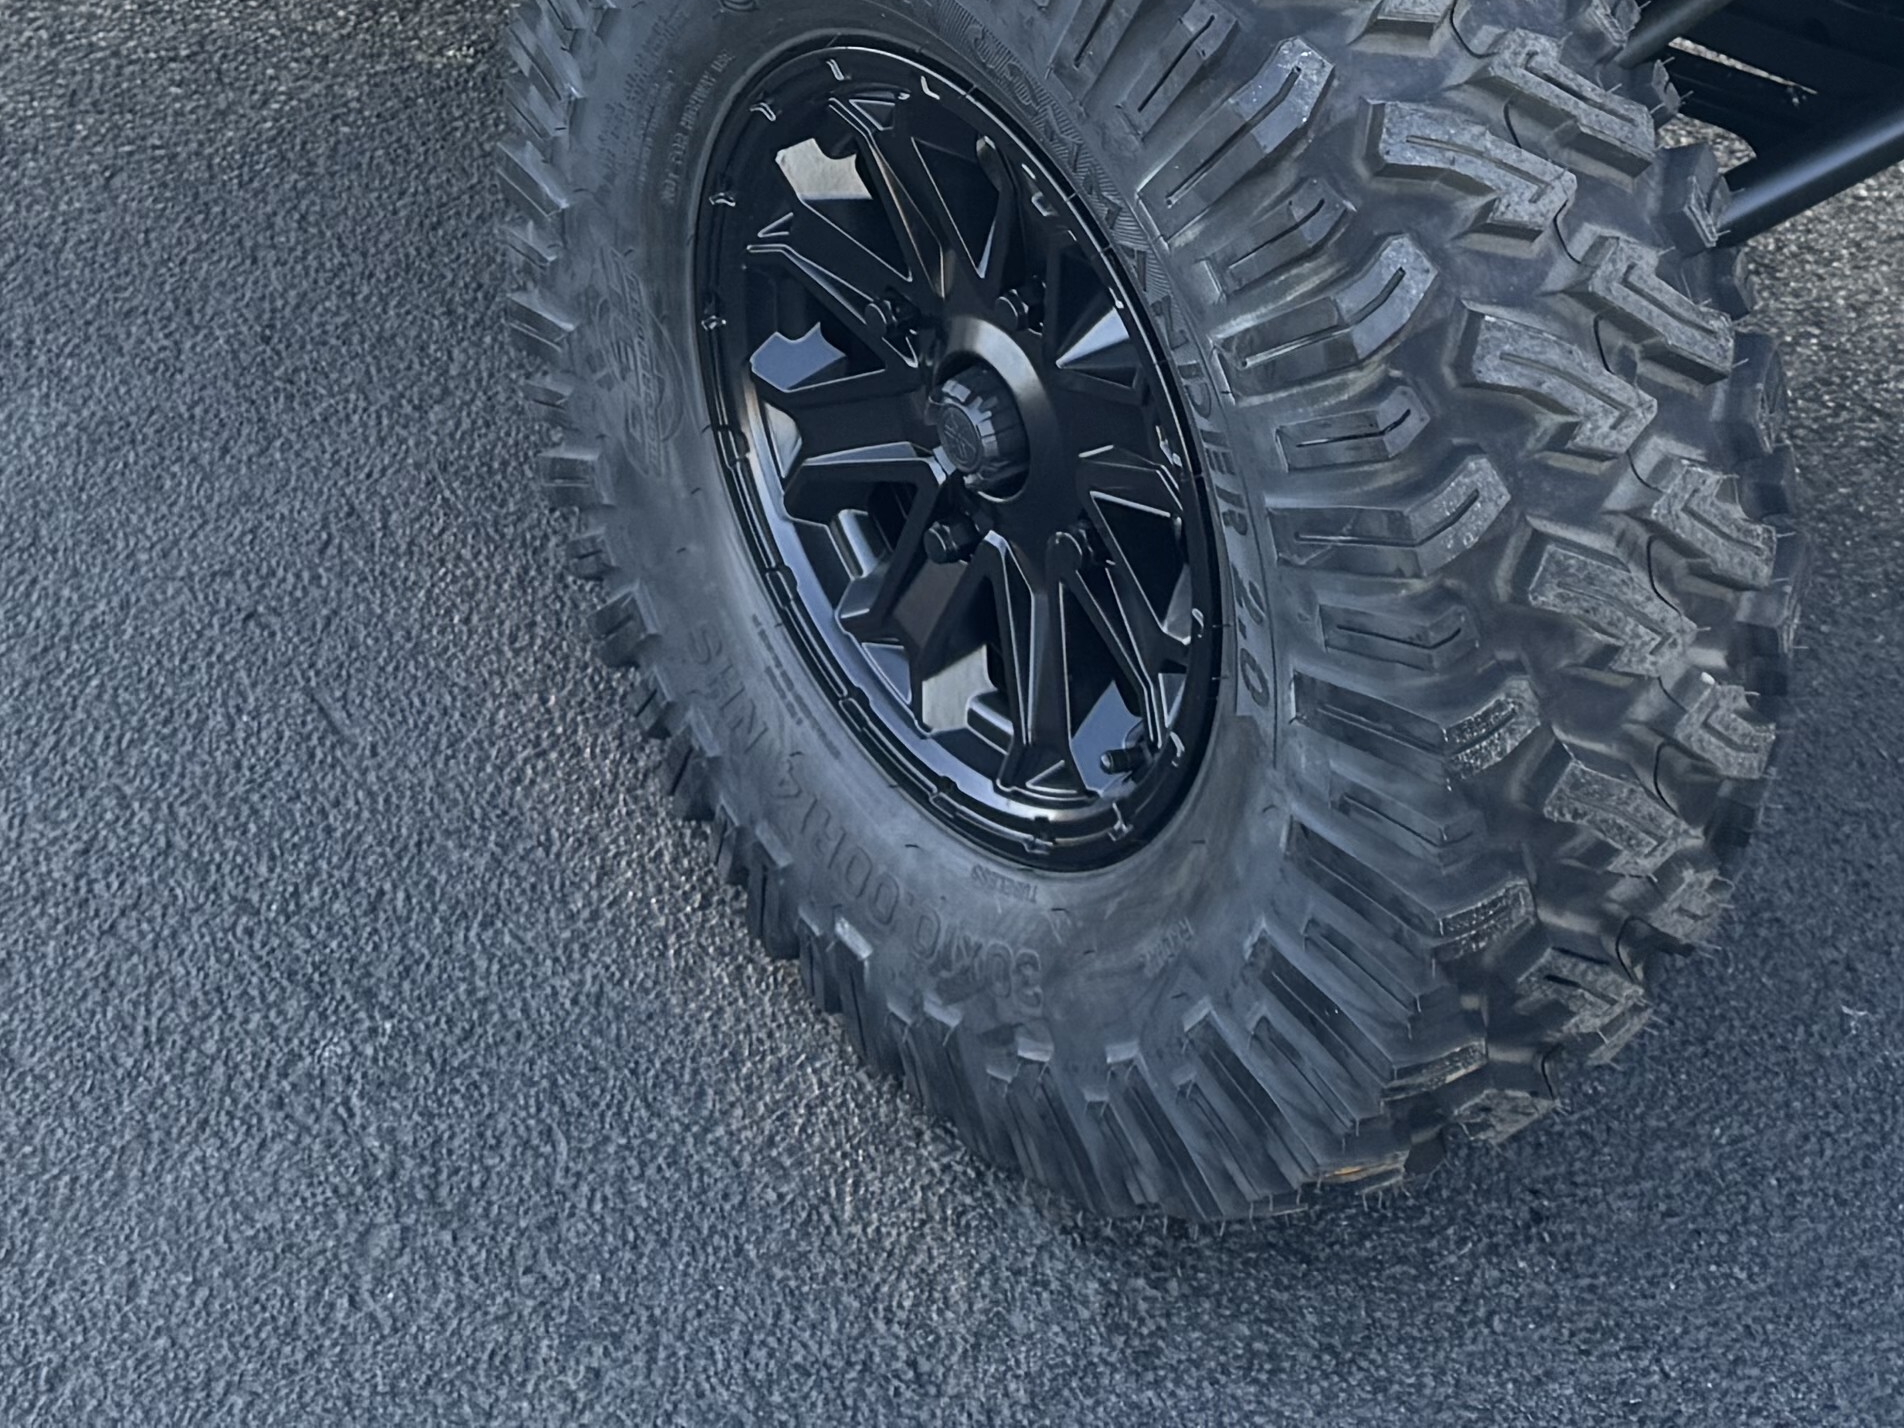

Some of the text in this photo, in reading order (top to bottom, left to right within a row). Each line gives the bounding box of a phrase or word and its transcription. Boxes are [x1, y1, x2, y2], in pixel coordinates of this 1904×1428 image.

[962, 23, 1248, 539] COMMANDER
[1232, 564, 1271, 712] 2.0
[686, 622, 769, 755] NHS
